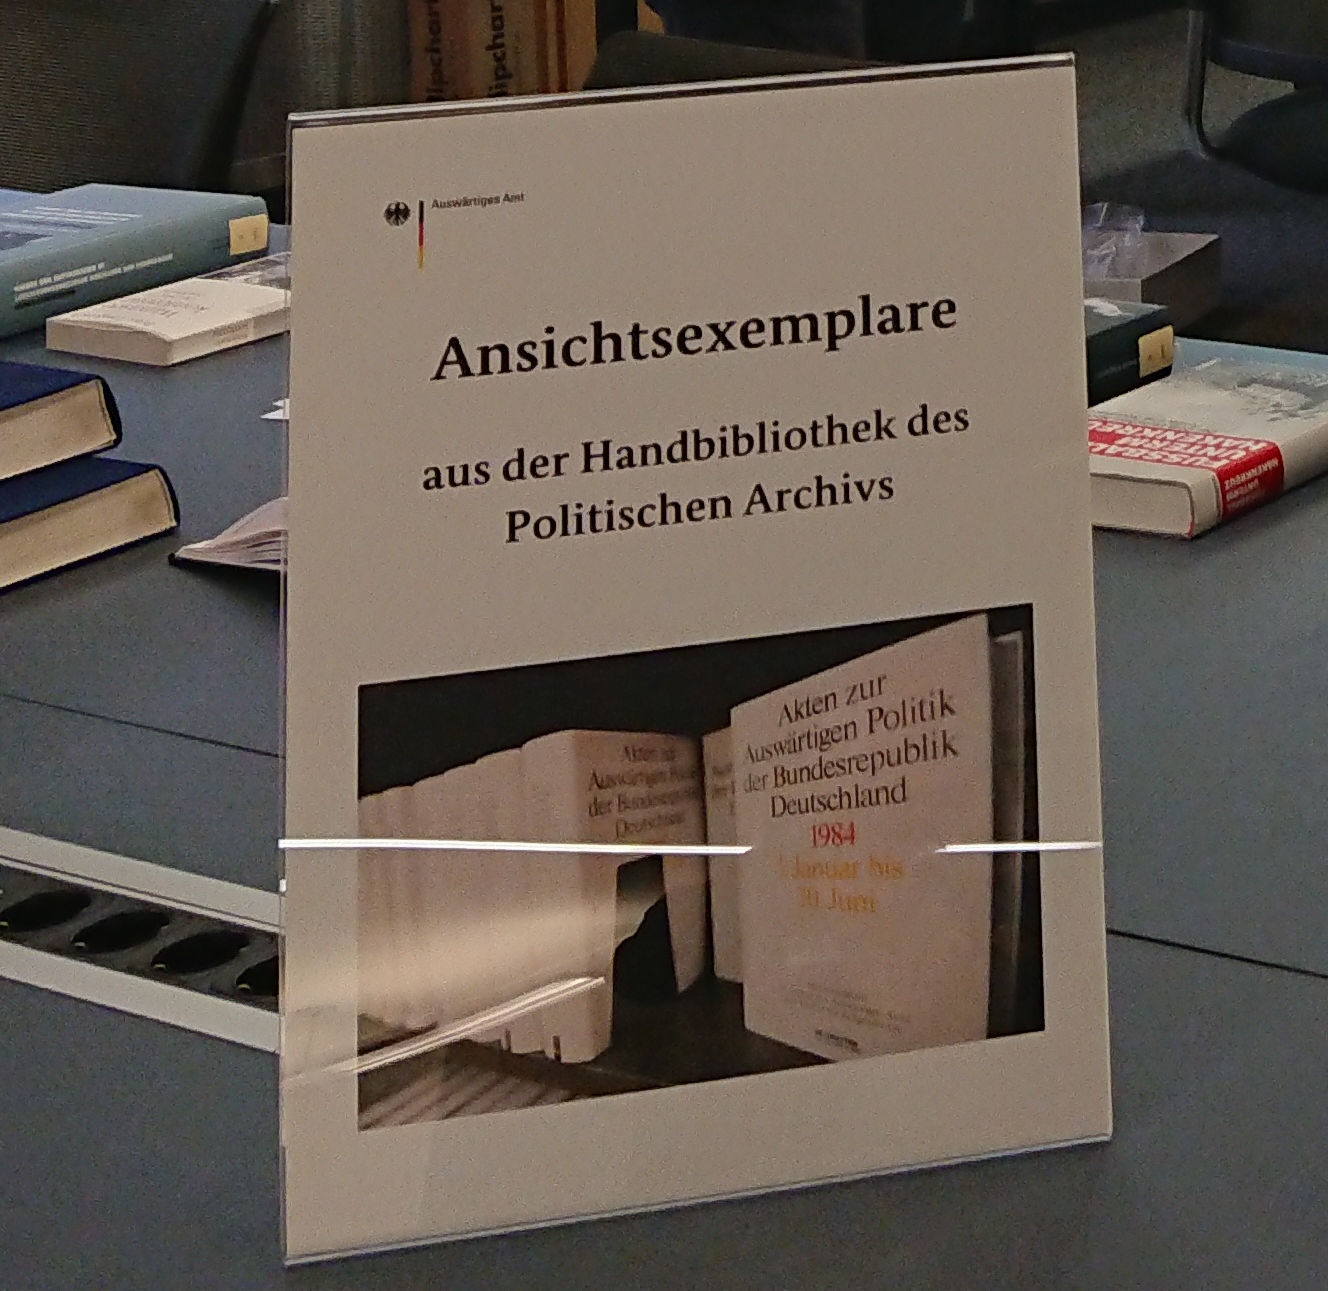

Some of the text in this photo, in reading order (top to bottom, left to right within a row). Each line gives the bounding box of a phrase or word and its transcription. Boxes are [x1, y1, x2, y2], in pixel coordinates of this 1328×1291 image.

[431, 191, 525, 210] Auswärtiges Amt
[429, 293, 958, 381] Ansichtsexemplare
[422, 403, 970, 491] aus der Handbibliothek des
[1088, 420, 1268, 452] HAKENKRE
[1089, 441, 1231, 469] FUSSBAL
[505, 471, 895, 544] Politischen Archivs
[744, 688, 956, 765] Auswärtigen Politik
[778, 674, 887, 727] Akten zur
[743, 772, 769, 794] der
[772, 728, 960, 789] Bundesrepublik
[770, 775, 907, 818] Deutschland
[811, 821, 856, 848] 1984
